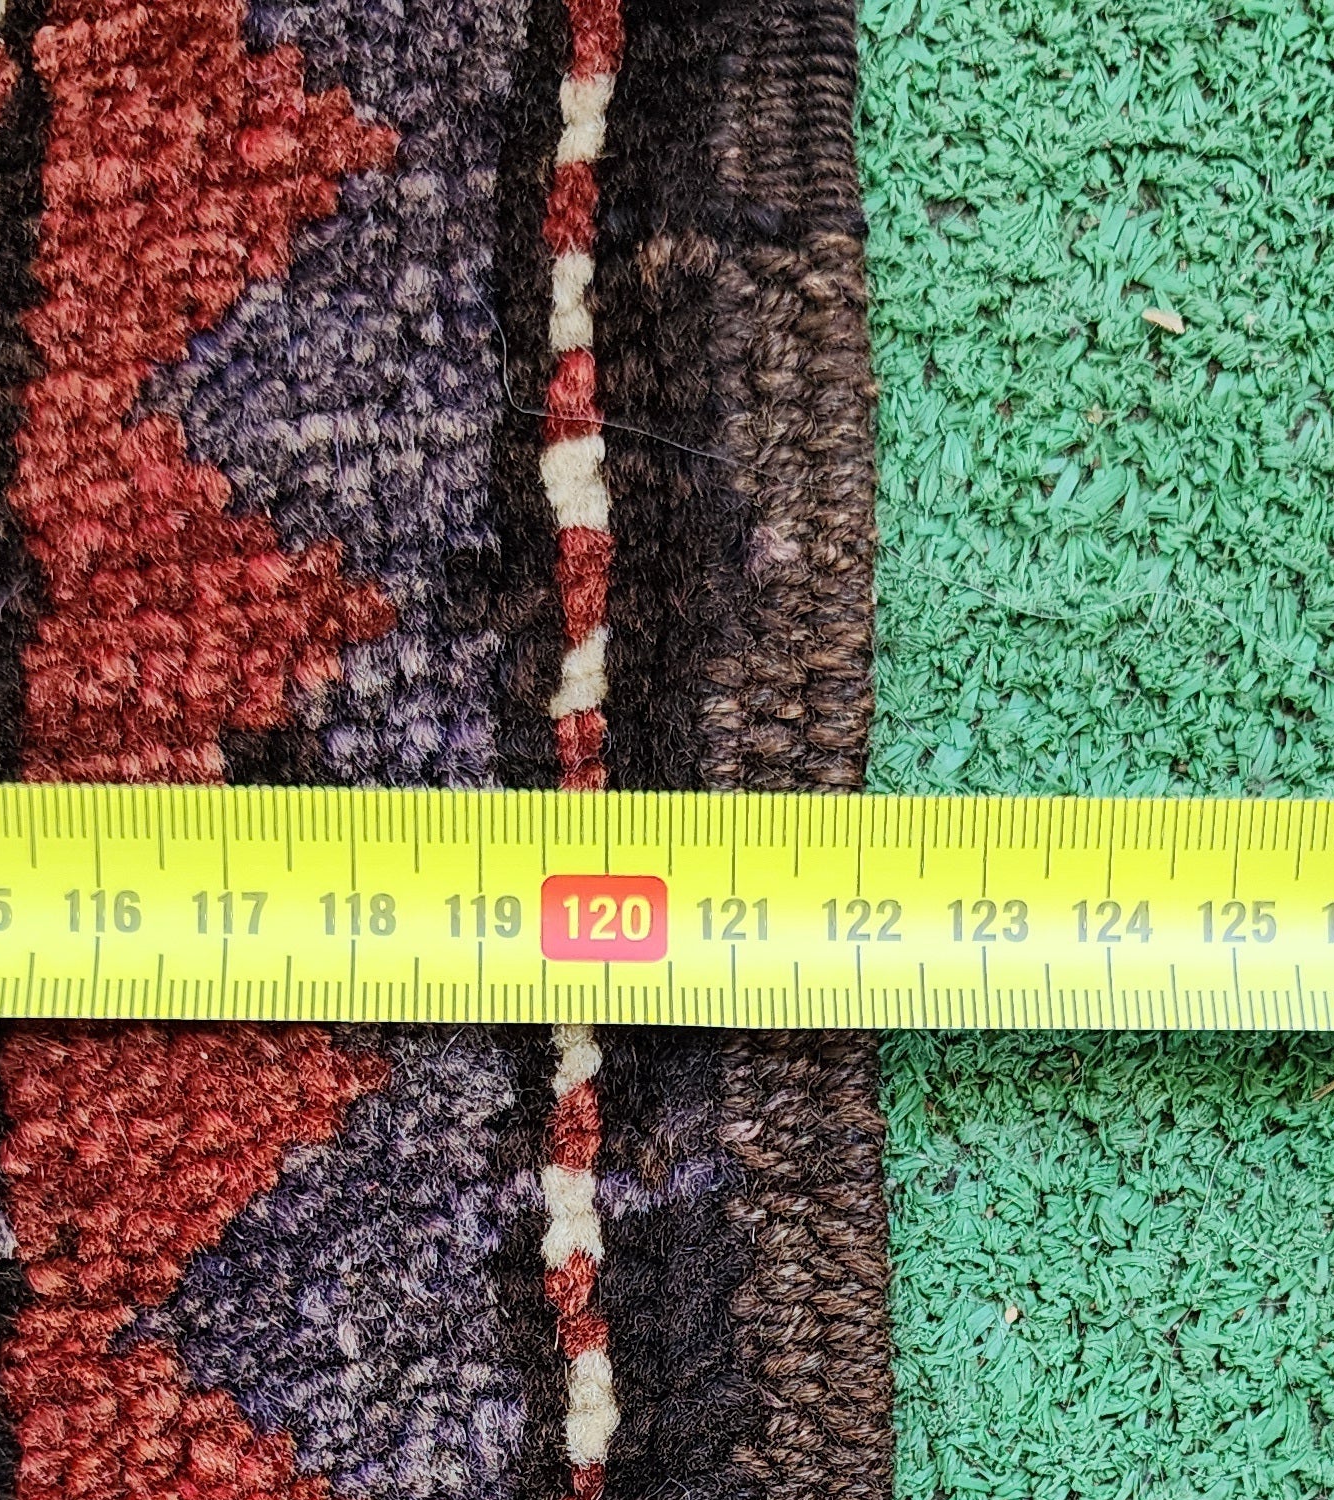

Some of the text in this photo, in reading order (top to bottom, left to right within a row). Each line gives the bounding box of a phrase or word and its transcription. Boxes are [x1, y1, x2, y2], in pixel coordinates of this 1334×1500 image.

[64, 889, 142, 933] 116
[192, 890, 268, 935] 117
[319, 892, 396, 936] 118
[445, 894, 521, 938] 119
[562, 894, 653, 941] 120
[696, 897, 767, 941] 121
[822, 898, 902, 942] 122
[947, 898, 1028, 942] 123
[1072, 899, 1153, 943] 124
[1198, 900, 1277, 943] 125
